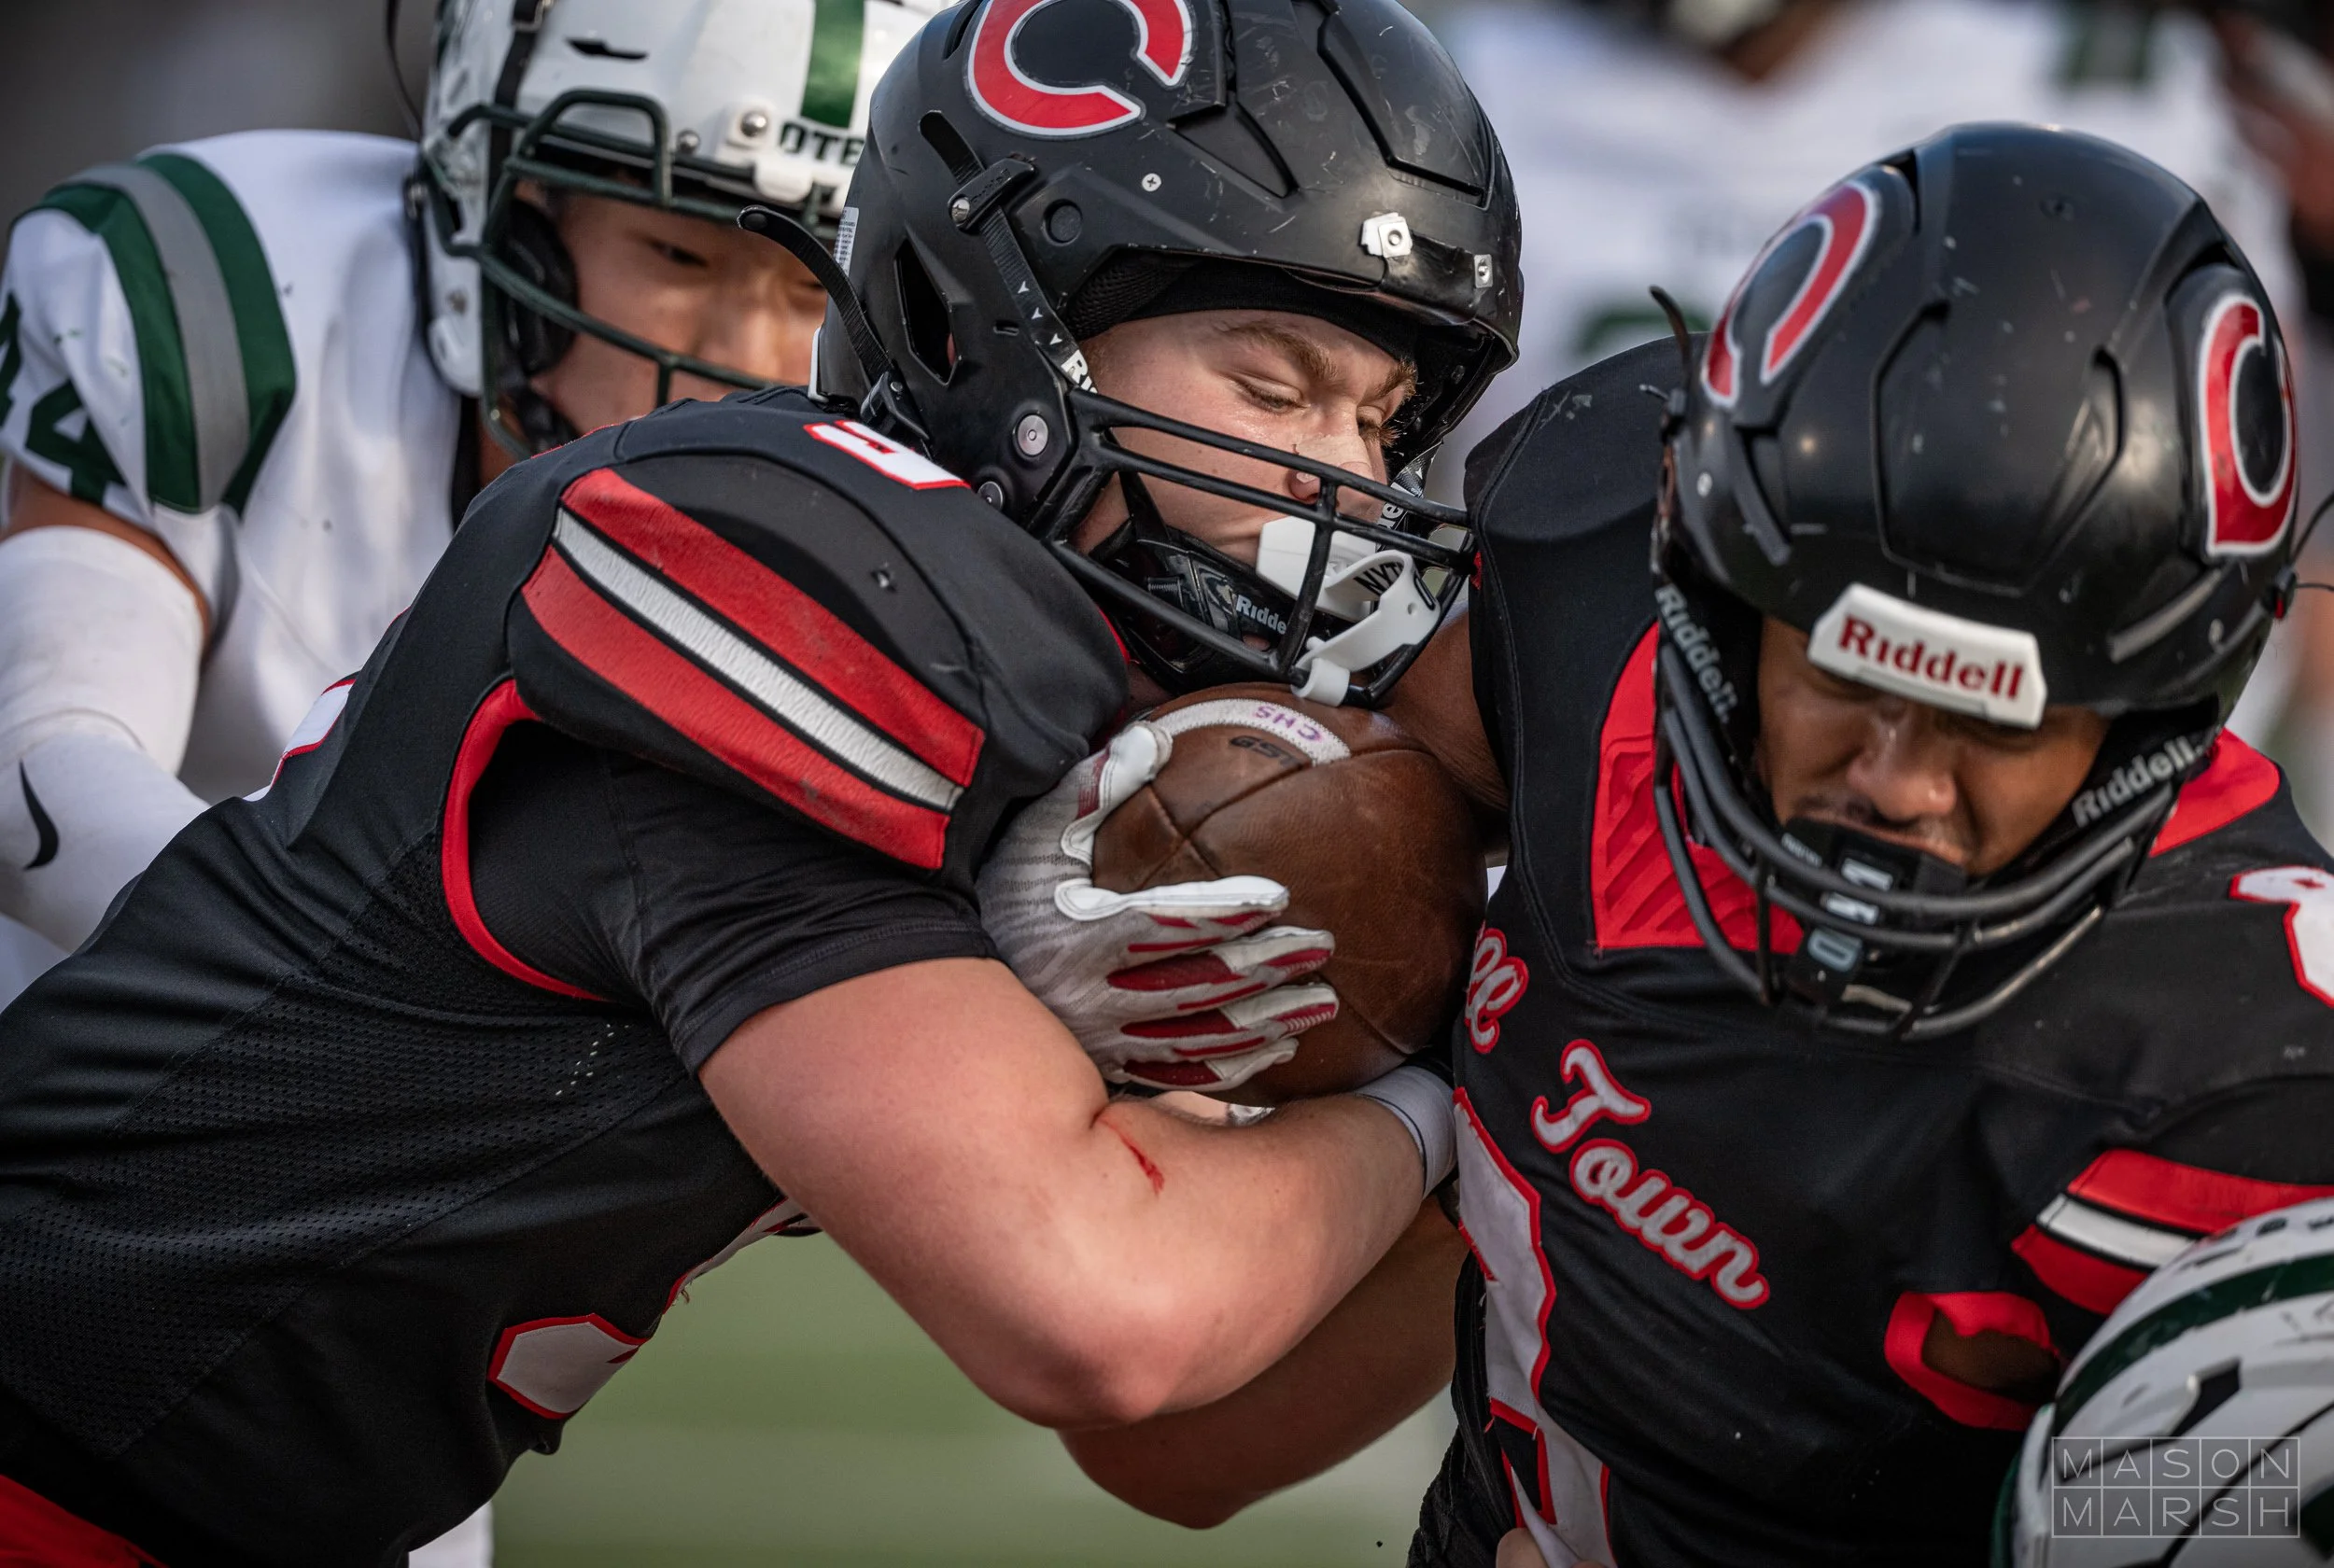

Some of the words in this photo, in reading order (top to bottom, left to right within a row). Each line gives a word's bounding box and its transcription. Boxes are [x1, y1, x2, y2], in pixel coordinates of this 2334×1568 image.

[967, 0, 1193, 137] C
[1701, 180, 1880, 407] C
[1235, 595, 1287, 635] Ridde
[1654, 582, 1737, 723] Riddell
[1838, 614, 2024, 700] Riddell
[1254, 705, 1322, 742] CHS
[2072, 735, 2195, 828] Riddell
[1531, 1039, 1770, 1308] Town
